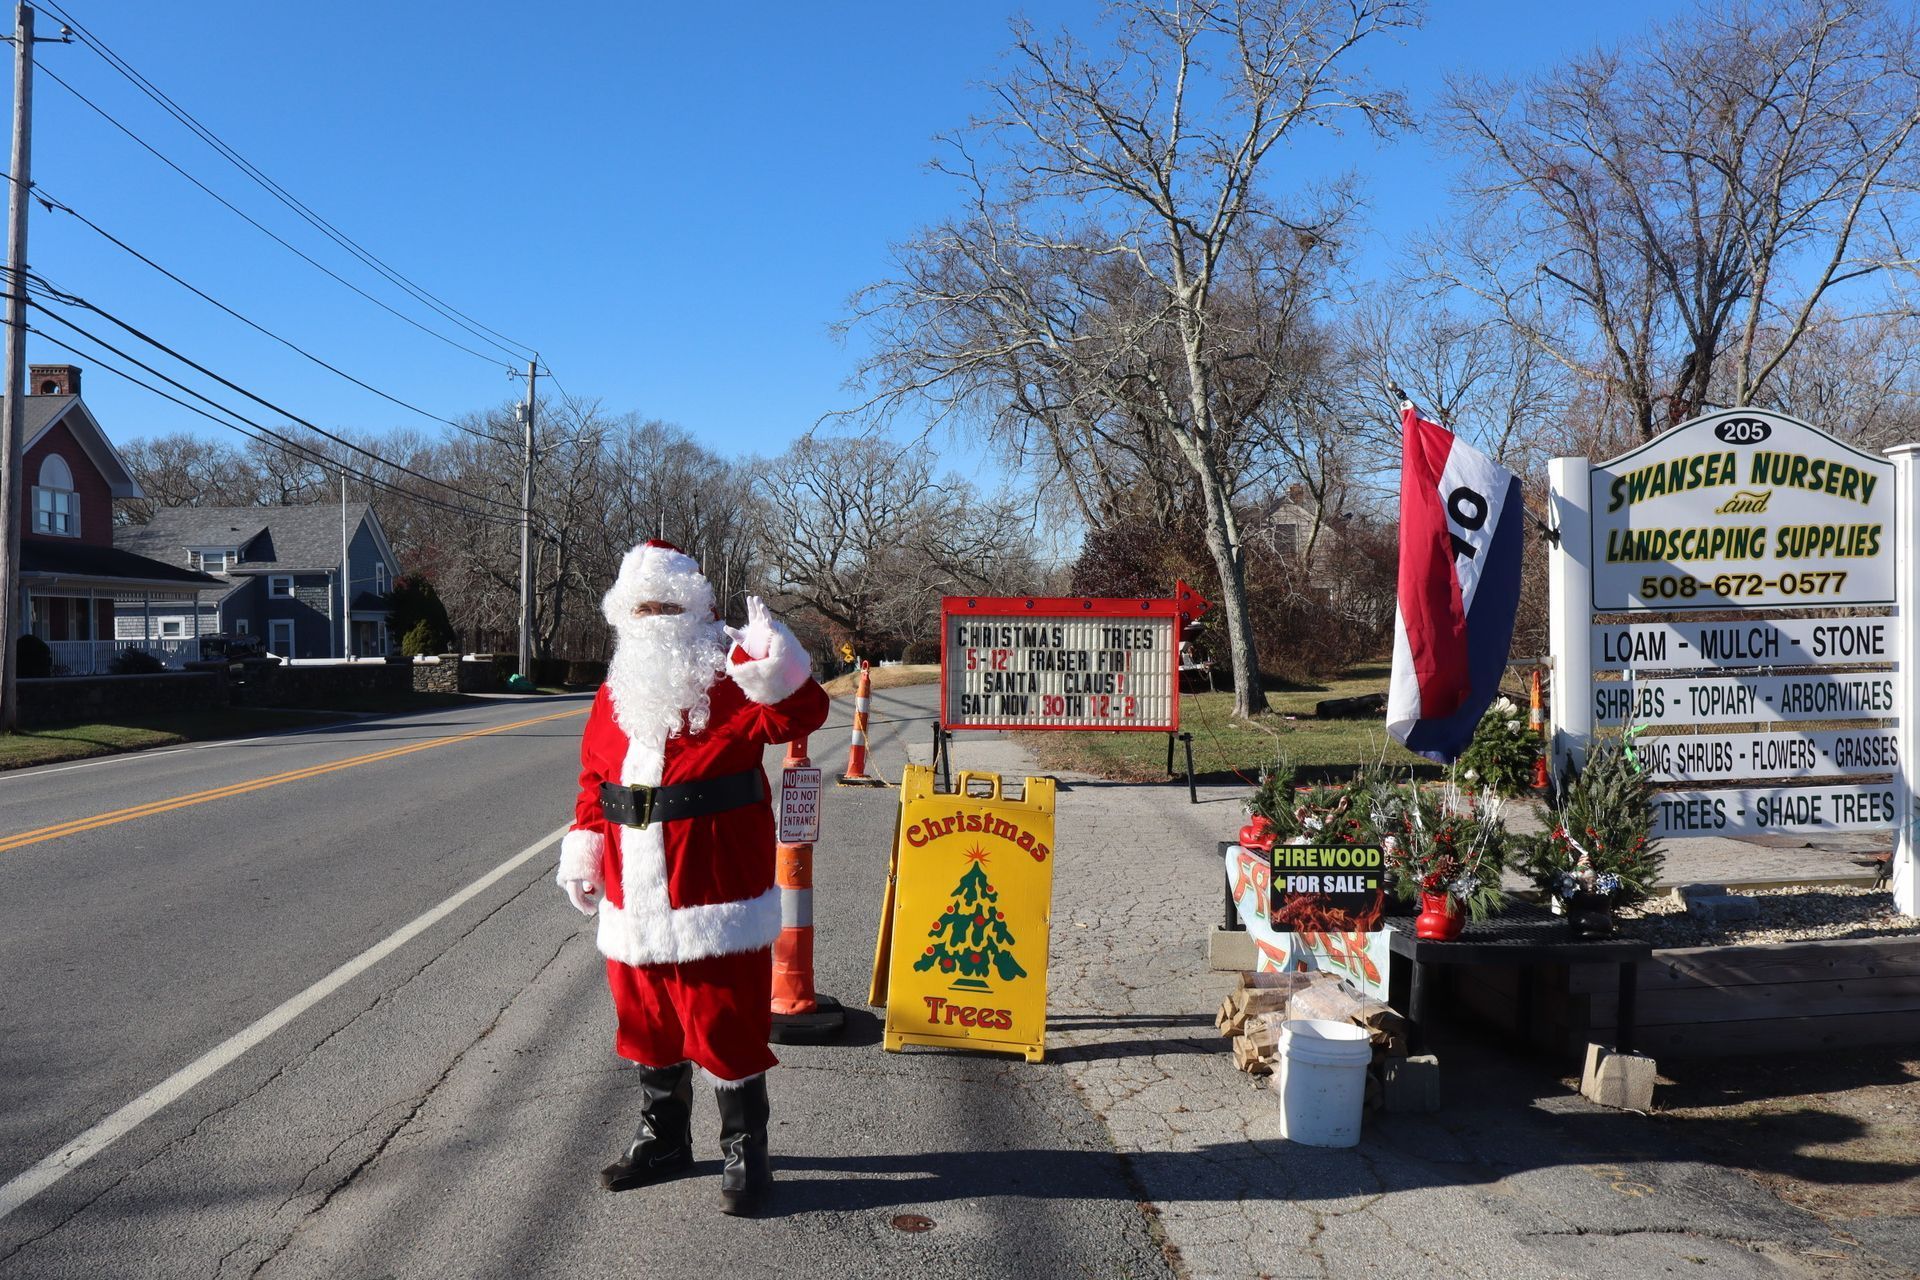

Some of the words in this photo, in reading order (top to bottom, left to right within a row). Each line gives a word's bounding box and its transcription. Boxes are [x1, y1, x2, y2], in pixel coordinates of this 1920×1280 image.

[1723, 422, 1764, 441] 205
[1607, 452, 1736, 513] SWANSEA
[1750, 452, 1877, 506] NURSERY
[1715, 491, 1772, 514] and
[1606, 527, 1765, 562] LANDSCAPING
[1775, 525, 1882, 559] SUPPLIES
[1640, 572, 1848, 599] 508-672-0577
[958, 626, 1063, 648] CHRISTMAS
[1102, 627, 1154, 649] TREES
[1603, 631, 1666, 662] LOAM
[1700, 628, 1779, 660] MULCH
[1813, 625, 1885, 657] STONE
[1029, 651, 1087, 671] FRASER
[1099, 652, 1131, 672] FIR!
[983, 672, 1037, 693] SANTA
[1064, 673, 1124, 694] CLAUS!
[961, 695, 991, 715] SAT
[1042, 695, 1082, 717] 30TH
[1596, 687, 1665, 720] SHRUBS
[1689, 685, 1758, 716] TOPIARY
[1780, 680, 1893, 713] ARBORVITAES
[1677, 741, 1733, 773] SHRUBS
[1752, 738, 1816, 770] FLOWERS
[1835, 735, 1898, 768] GRASSES
[784, 772, 796, 786] NO
[796, 774, 819, 784] PARKING
[786, 791, 798, 800] DO
[801, 790, 817, 800] NOT
[786, 803, 815, 813] BLOCK
[1661, 799, 1726, 830] TREES
[1756, 794, 1822, 828] SHADE
[1831, 791, 1895, 824] TREES
[784, 816, 816, 826] ENTRANCE
[906, 810, 1050, 863] Christmas
[1274, 848, 1381, 867] FIREWOOD
[1287, 875, 1320, 893] FOR
[1324, 875, 1365, 893] SALE
[923, 996, 1013, 1030] Trees
